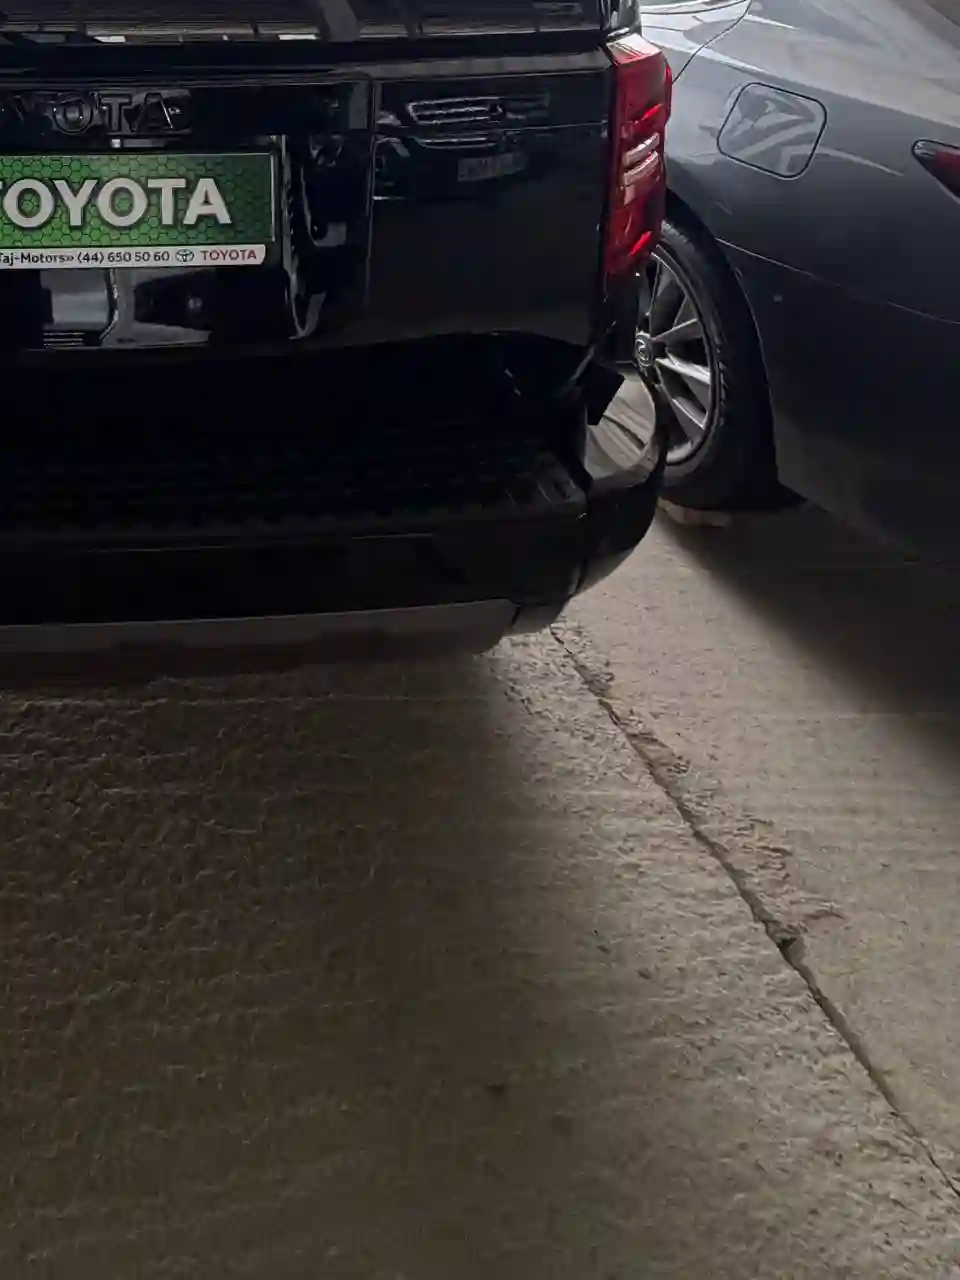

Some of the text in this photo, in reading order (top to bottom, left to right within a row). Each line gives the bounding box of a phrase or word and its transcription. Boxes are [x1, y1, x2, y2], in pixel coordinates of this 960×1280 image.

[77, 251, 105, 264] (44)
[107, 251, 132, 263] 650
[134, 251, 150, 262] 50
[153, 250, 170, 262] 60
[200, 249, 257, 261] TOYOTA
